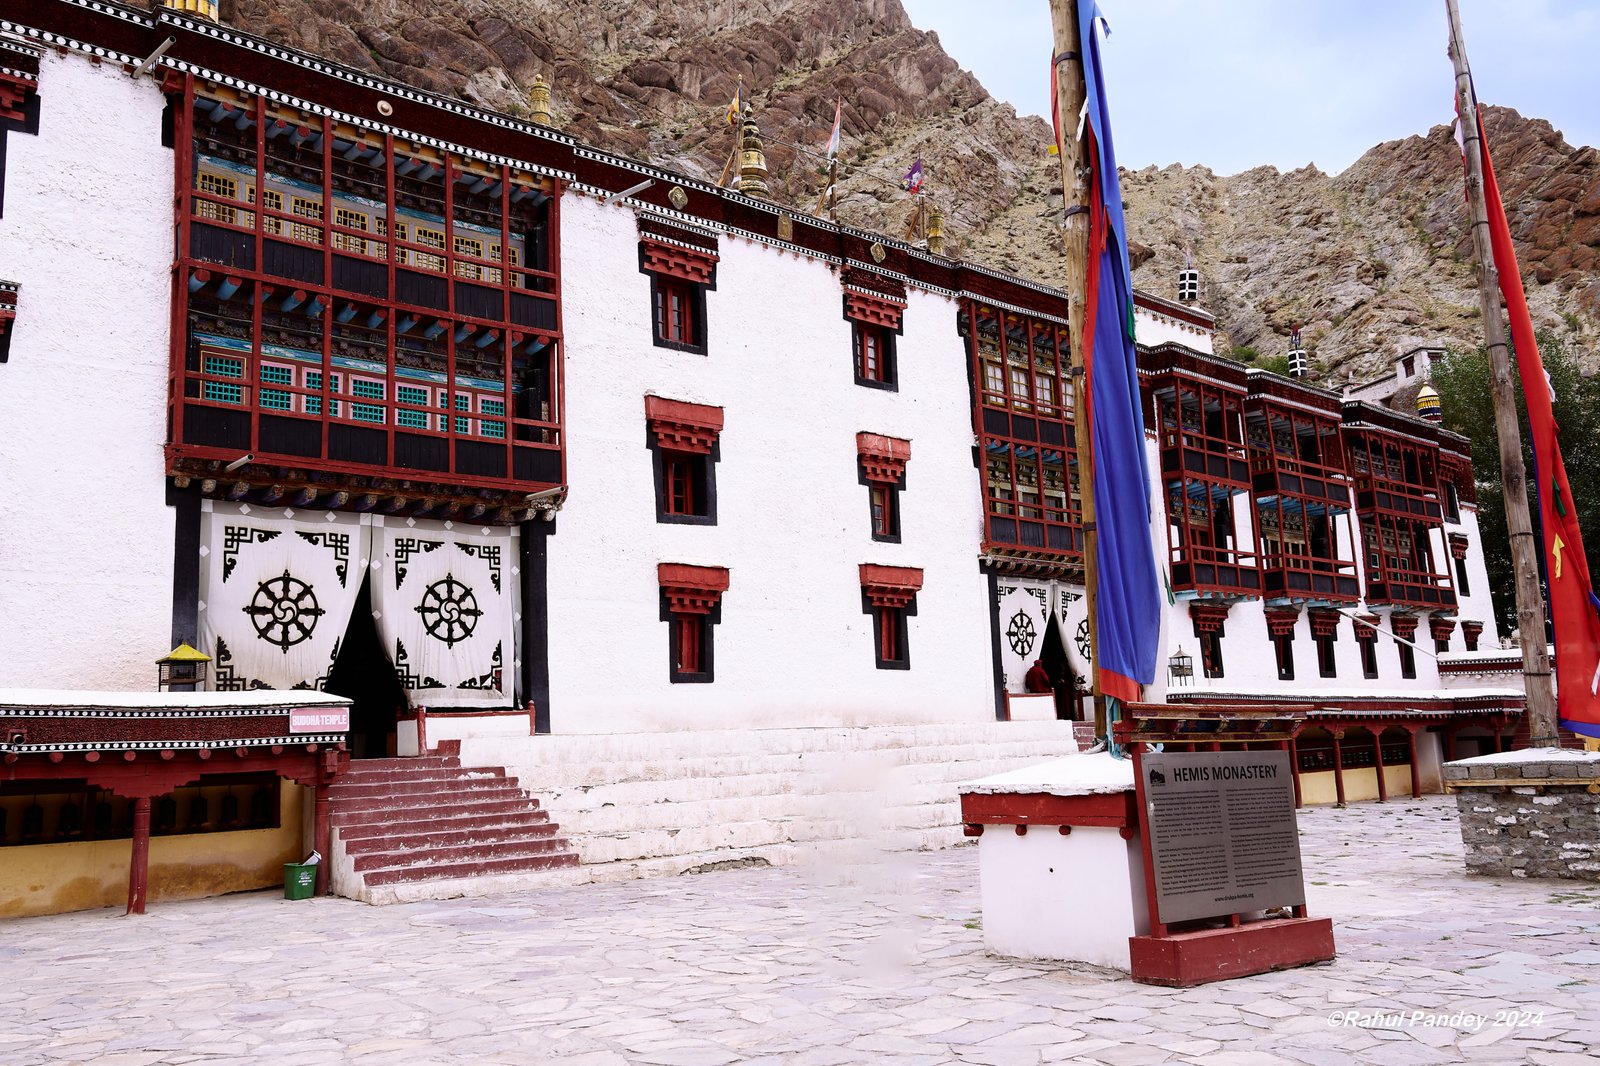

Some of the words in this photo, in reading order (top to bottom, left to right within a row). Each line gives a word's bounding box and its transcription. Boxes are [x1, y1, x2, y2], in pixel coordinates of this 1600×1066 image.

[292, 715, 320, 726] BUDDHA
[320, 714, 347, 725] TEMPLE
[1173, 766, 1209, 782] HEMIS
[1212, 764, 1277, 781] MONASTERY
